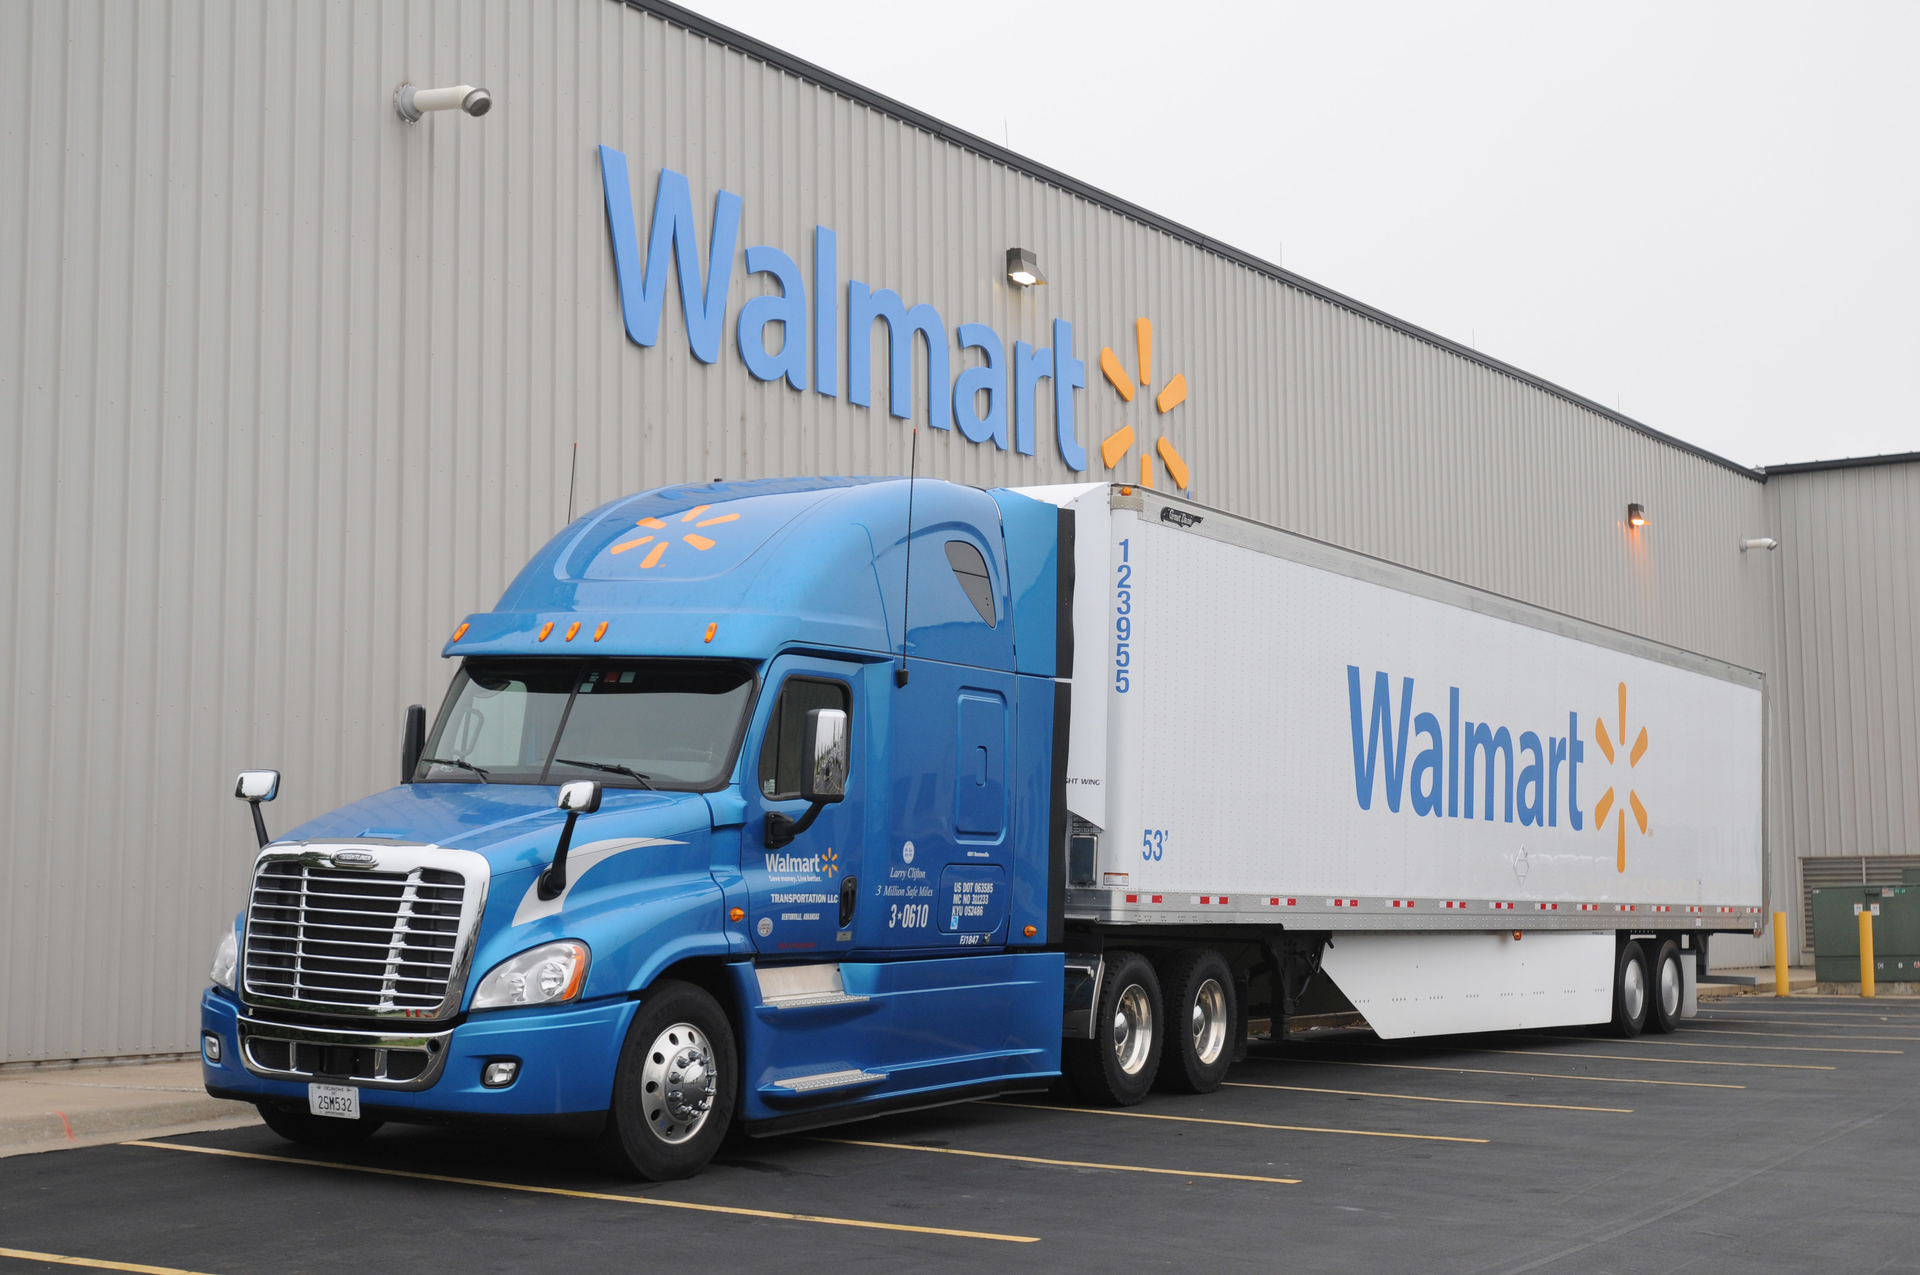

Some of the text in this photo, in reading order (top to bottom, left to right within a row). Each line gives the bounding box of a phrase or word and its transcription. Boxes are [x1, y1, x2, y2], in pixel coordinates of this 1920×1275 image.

[599, 144, 1087, 472] Walmart
[1346, 664, 1584, 831] Walmart
[1081, 778, 1101, 786] WING
[765, 853, 820, 873] Walmart
[889, 867, 926, 881] Larry Clifton
[875, 885, 934, 899] 3 Million Safe Miles
[953, 883, 962, 893] US
[962, 883, 974, 893] DOT
[770, 893, 839, 903] TRANSPORTATION LLC
[952, 894, 962, 905] MC
[962, 894, 971, 905] NO
[951, 905, 964, 917] KYU
[318, 1095, 352, 1112] 2SM532
